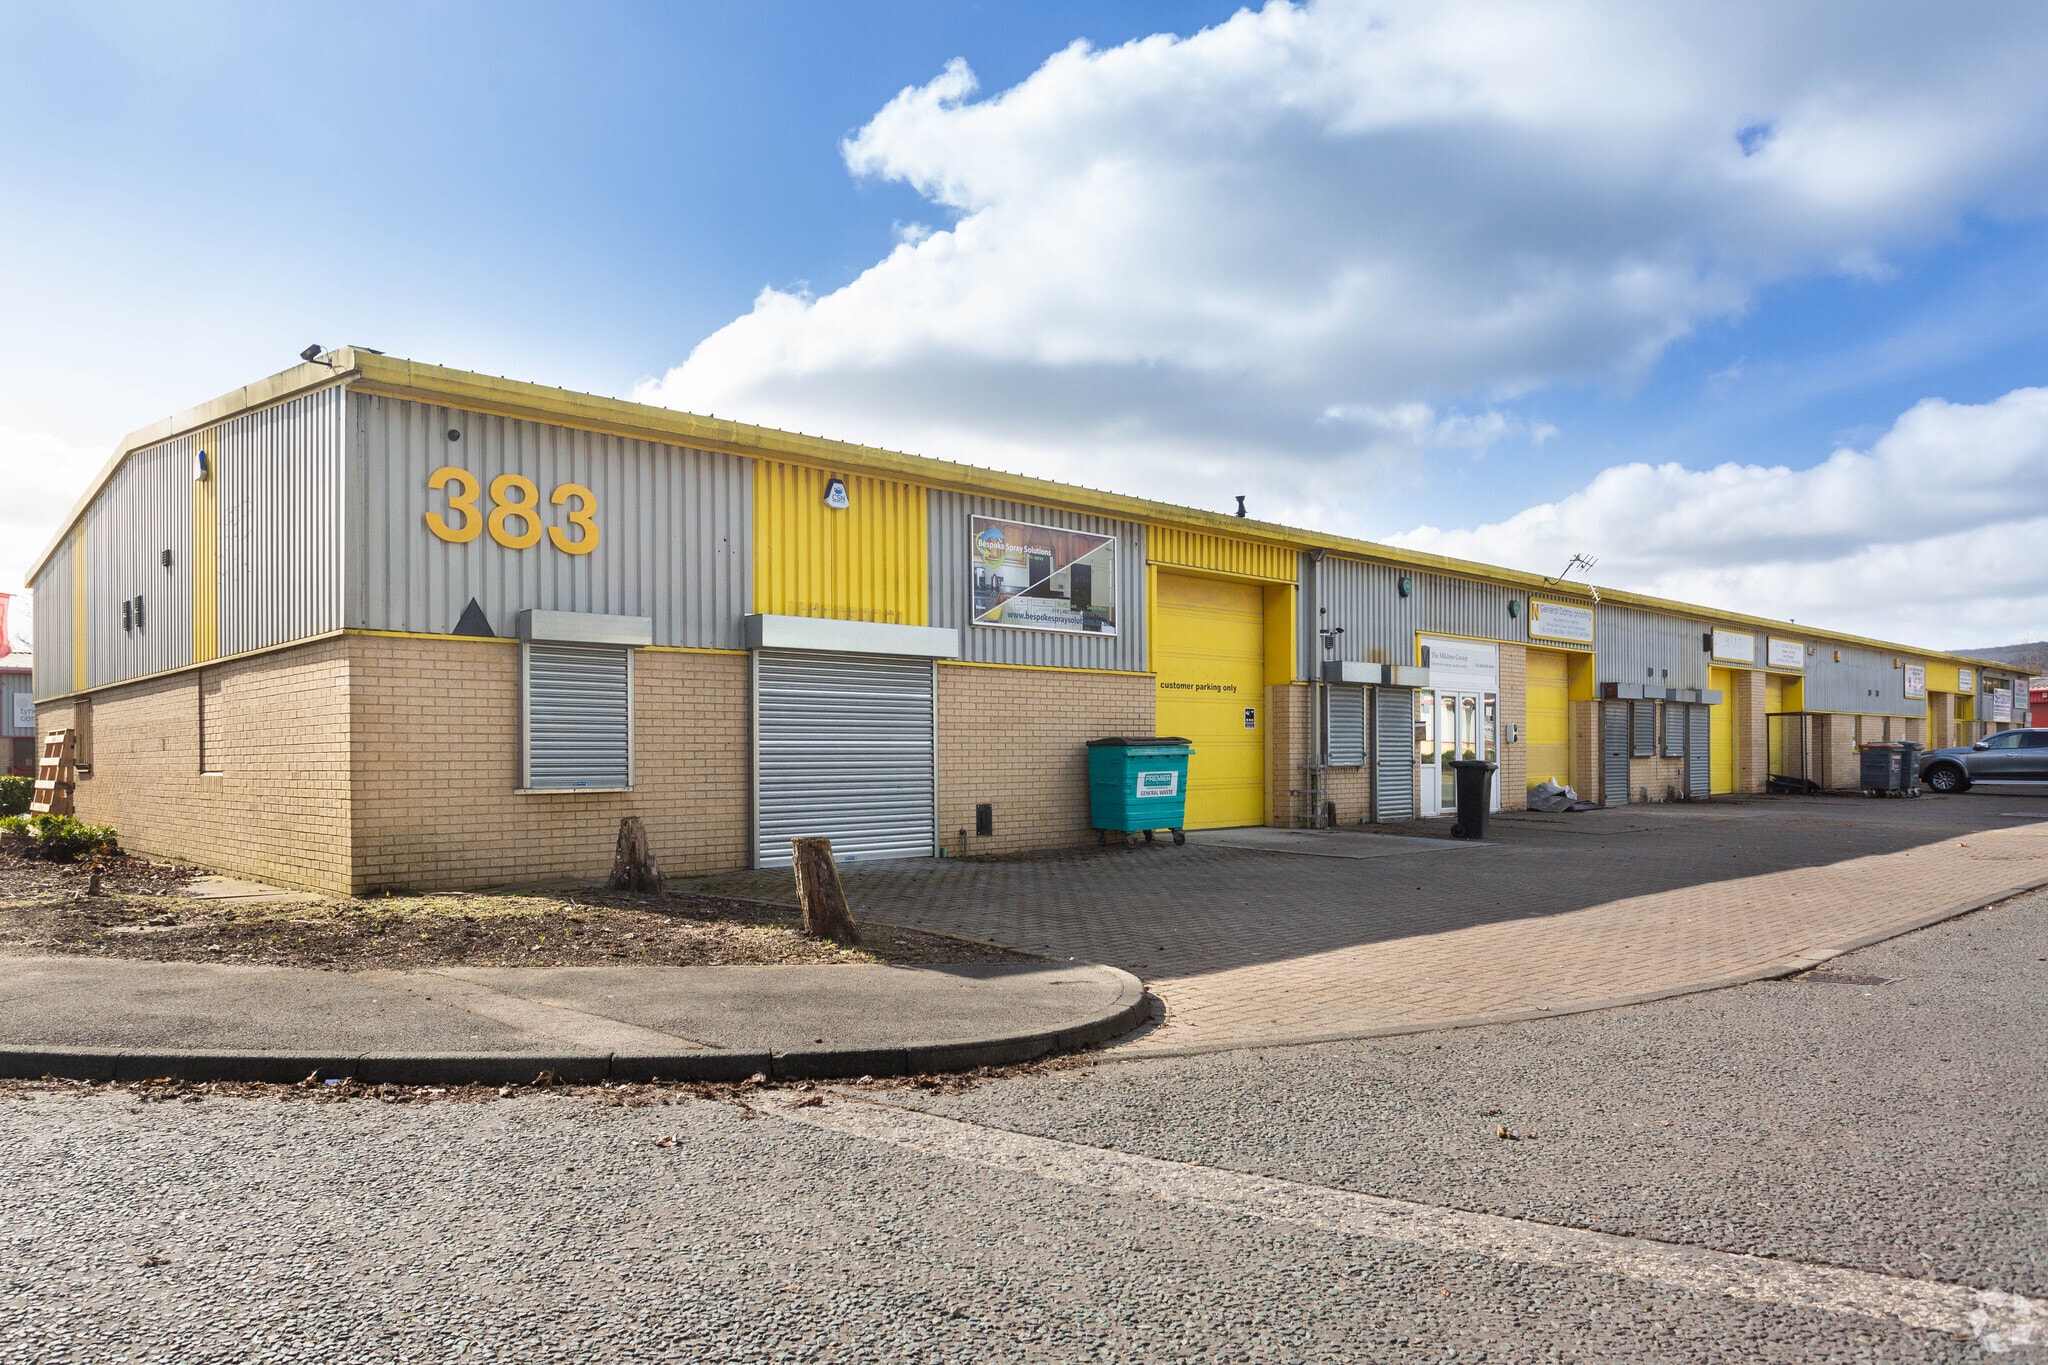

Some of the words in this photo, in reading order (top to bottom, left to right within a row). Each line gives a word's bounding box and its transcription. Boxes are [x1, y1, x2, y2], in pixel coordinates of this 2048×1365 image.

[425, 466, 600, 555] 383
[978, 539, 1005, 550] Bespoke
[1006, 543, 1023, 554] Spray
[1024, 545, 1052, 556] Solutions
[1540, 604, 1559, 615] General
[1007, 611, 1111, 626] www.bespokespraysolut
[1160, 681, 1194, 690] customer
[1195, 682, 1221, 693] parking
[1223, 683, 1237, 694] only
[1140, 789, 1159, 797] GENERAL
